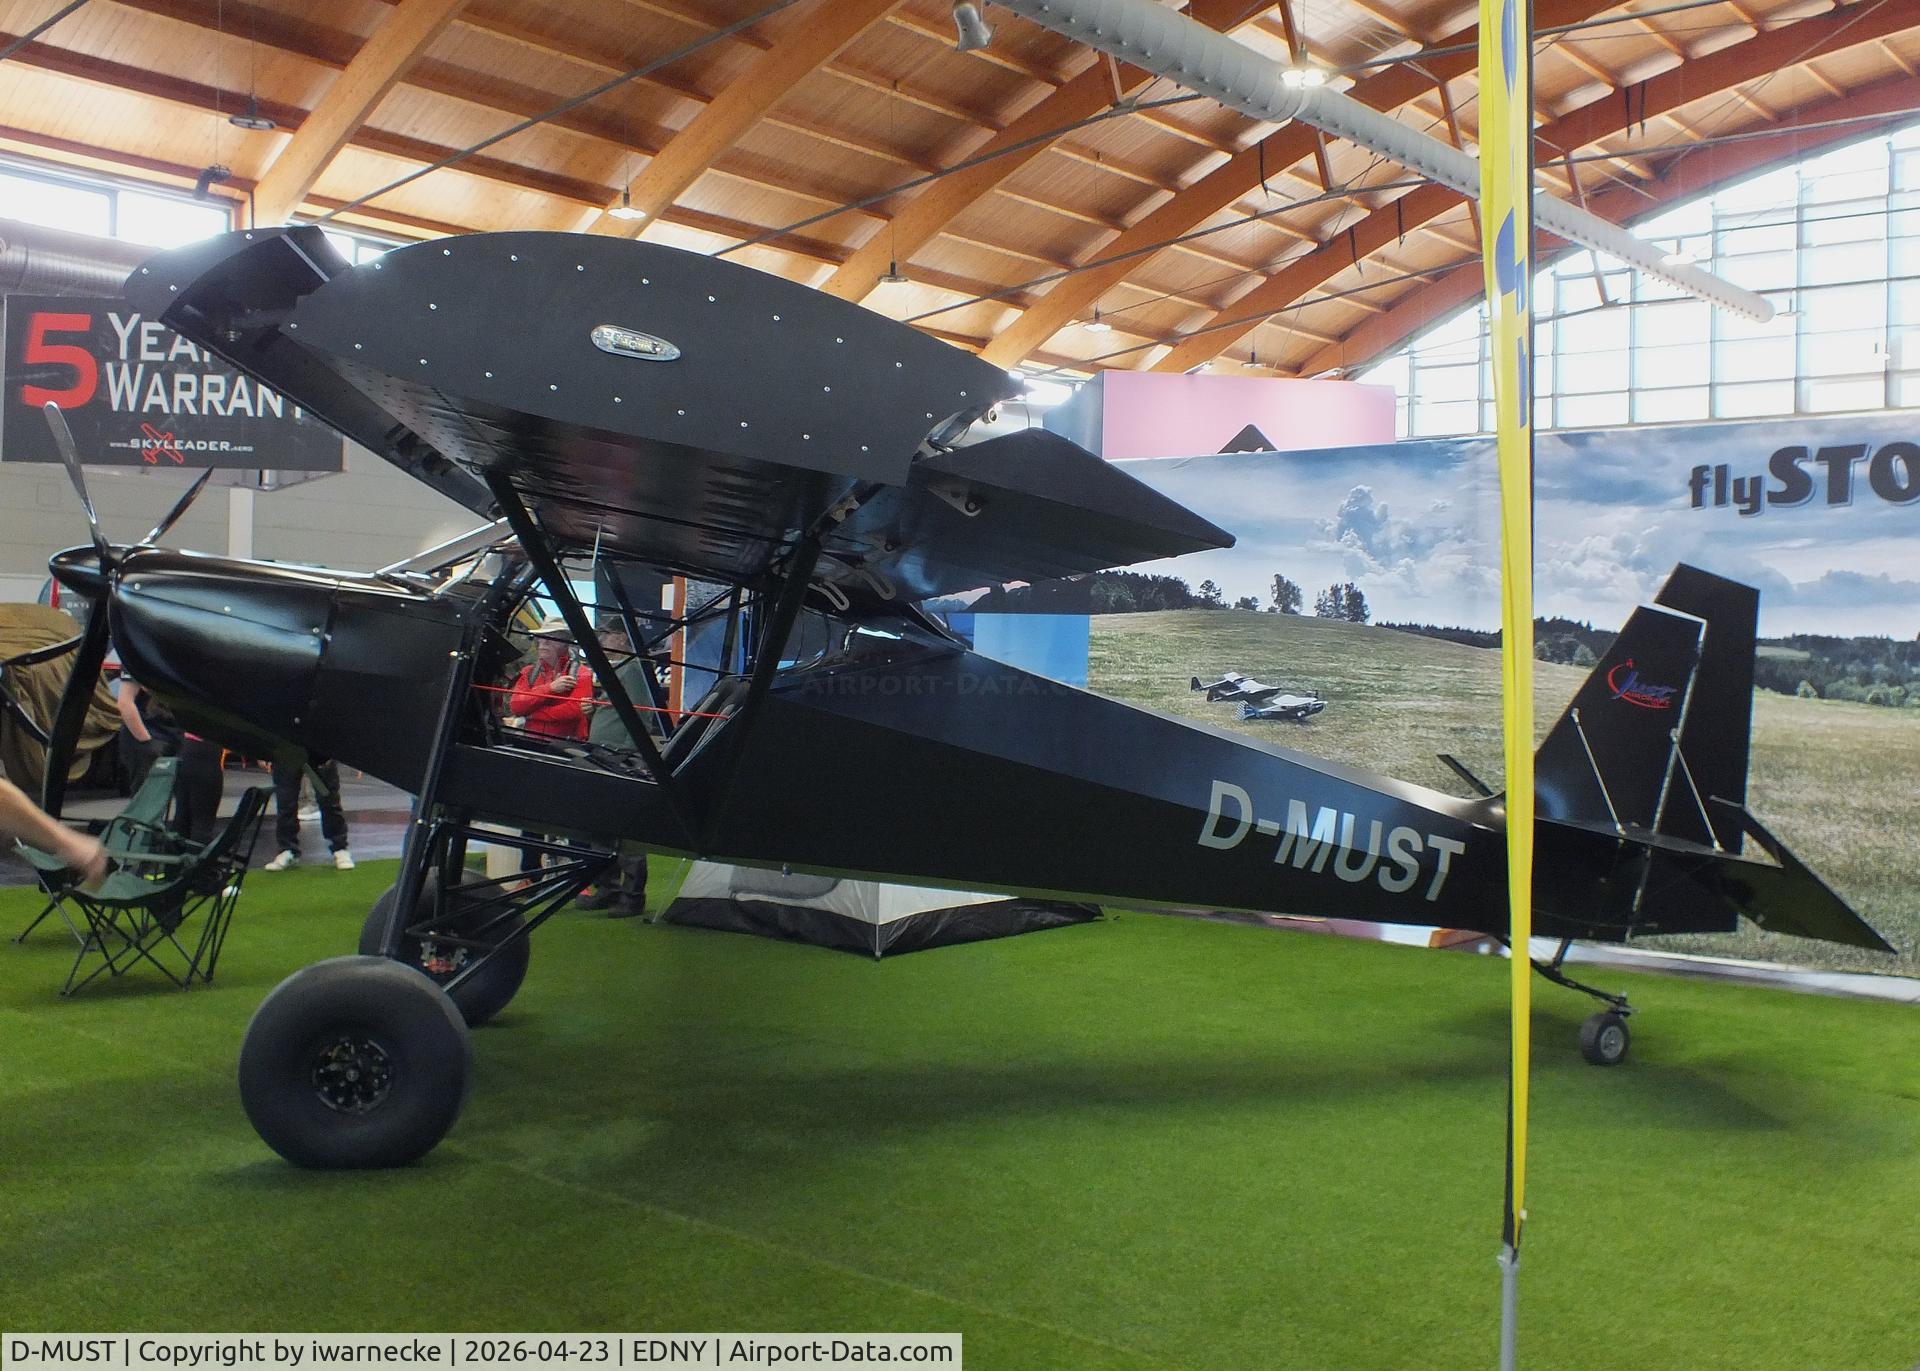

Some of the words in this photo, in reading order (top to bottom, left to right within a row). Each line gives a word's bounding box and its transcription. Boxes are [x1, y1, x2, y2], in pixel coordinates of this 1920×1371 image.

[22, 312, 98, 410] 5
[107, 312, 210, 363] YEA
[1198, 779, 1466, 902] D-MUST
